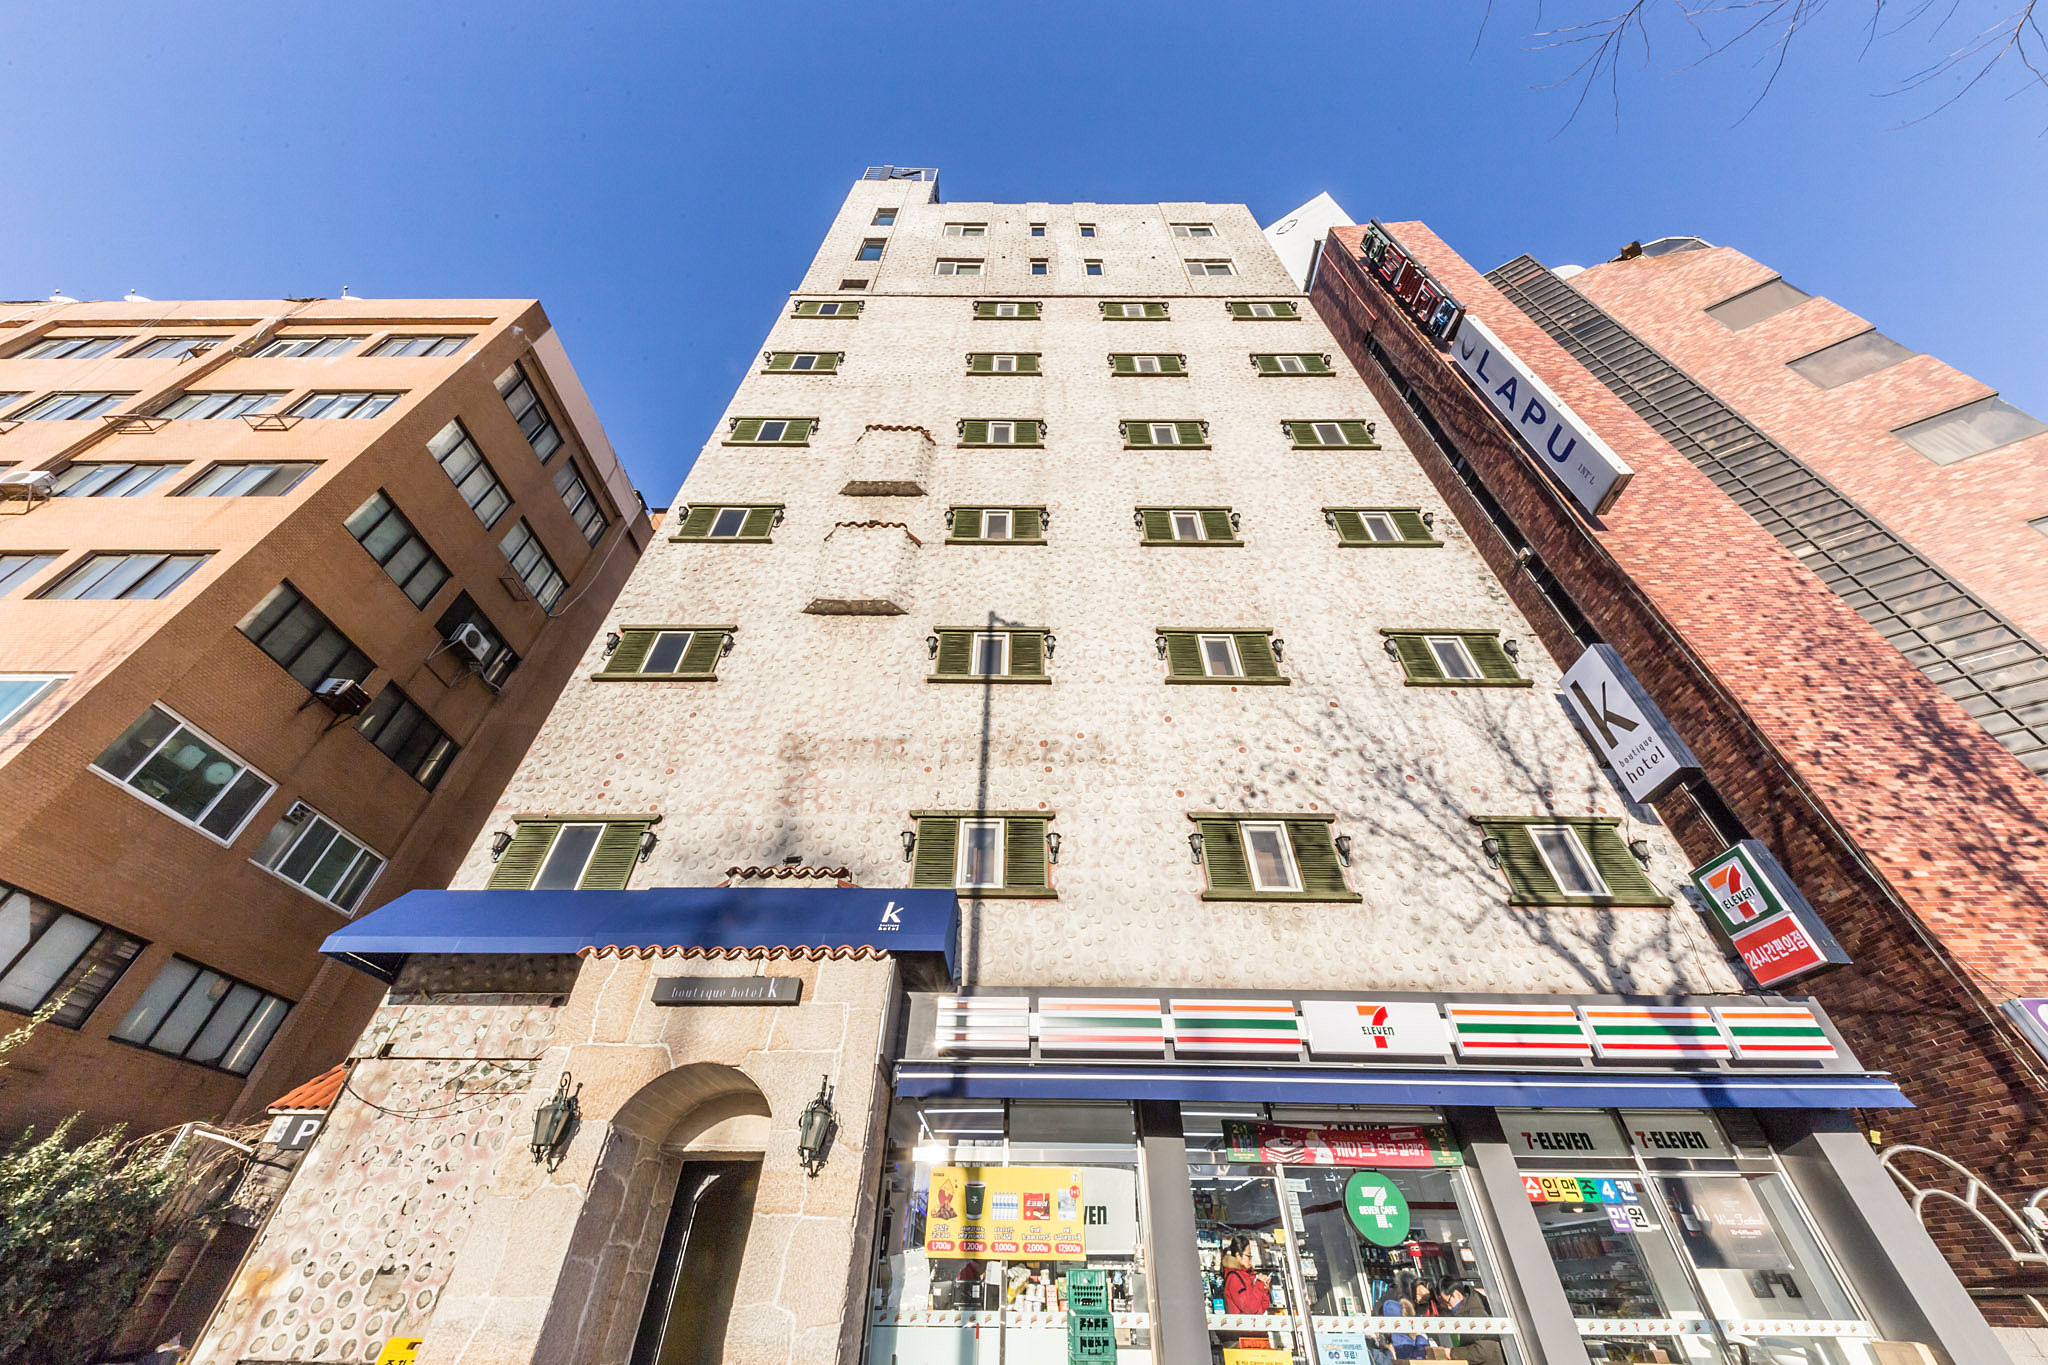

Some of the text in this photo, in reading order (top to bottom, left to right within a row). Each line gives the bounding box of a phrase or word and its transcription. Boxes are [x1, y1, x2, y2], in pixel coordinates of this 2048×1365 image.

[1476, 349, 1577, 463] LAPU
[1618, 736, 1653, 768] boutique
[1625, 745, 1666, 784] hotel
[1707, 864, 1758, 919] 7
[1722, 886, 1756, 909] ELEVEN
[1744, 930, 1809, 970] 24시간편의점
[671, 987, 726, 1000] boutique
[730, 986, 764, 998] hotel
[1356, 1005, 1388, 1049] 7
[1361, 1026, 1395, 1036] ELEVEN
[290, 1119, 321, 1145] P
[1521, 1131, 1595, 1150] 7-ELEVEN
[1635, 1130, 1710, 1150] 7-ELEVEN
